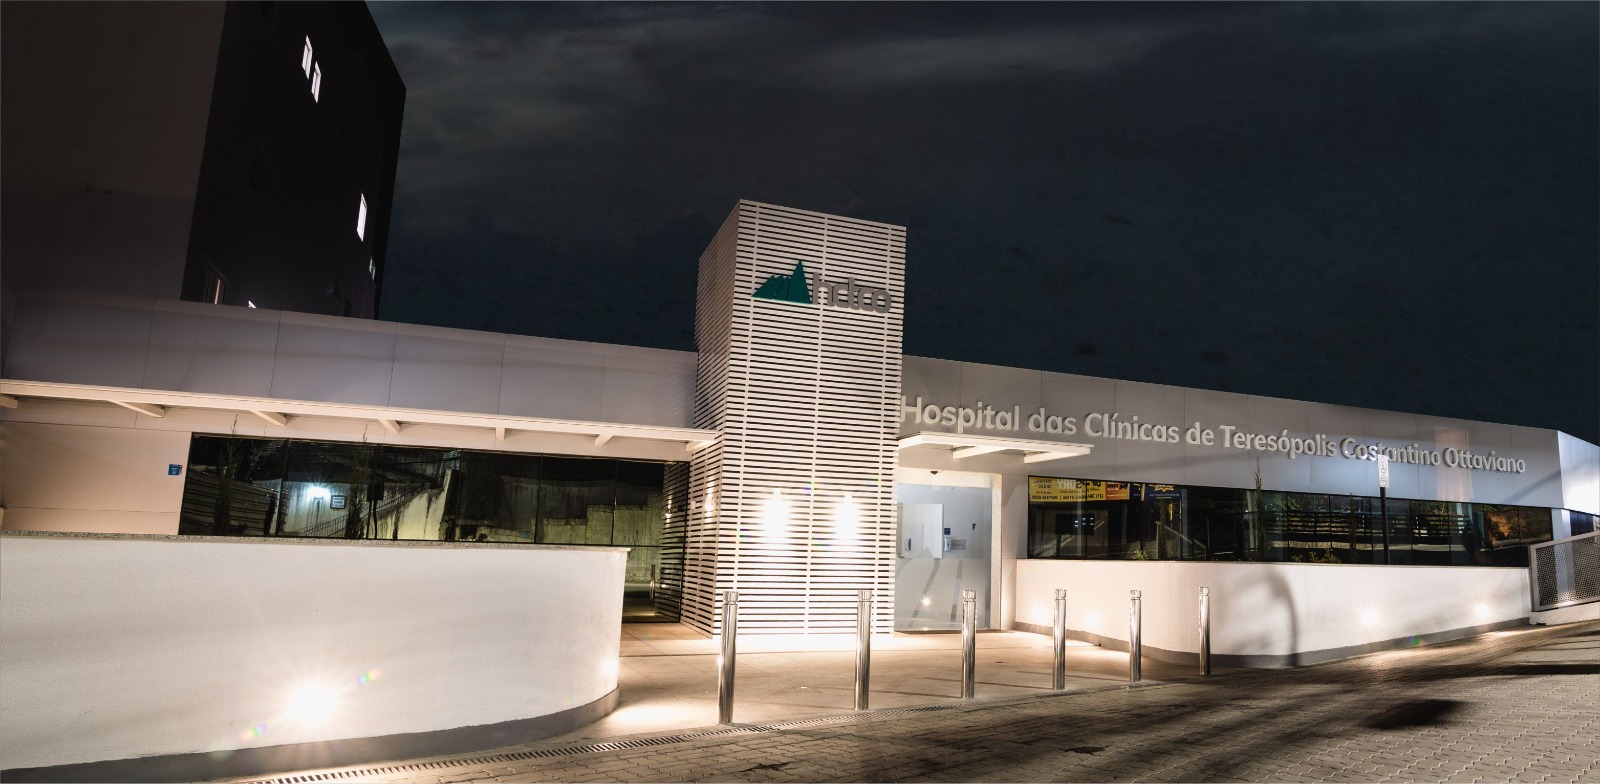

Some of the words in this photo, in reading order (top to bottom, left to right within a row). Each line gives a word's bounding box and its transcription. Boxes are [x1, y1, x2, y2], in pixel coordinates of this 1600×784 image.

[899, 396, 1020, 434] Hospital
[1028, 407, 1077, 435] das
[1084, 412, 1180, 443] Clínicas
[1185, 421, 1215, 446] de
[1219, 424, 1337, 459] Teresópolis
[1443, 447, 1526, 474] Ottaviano
